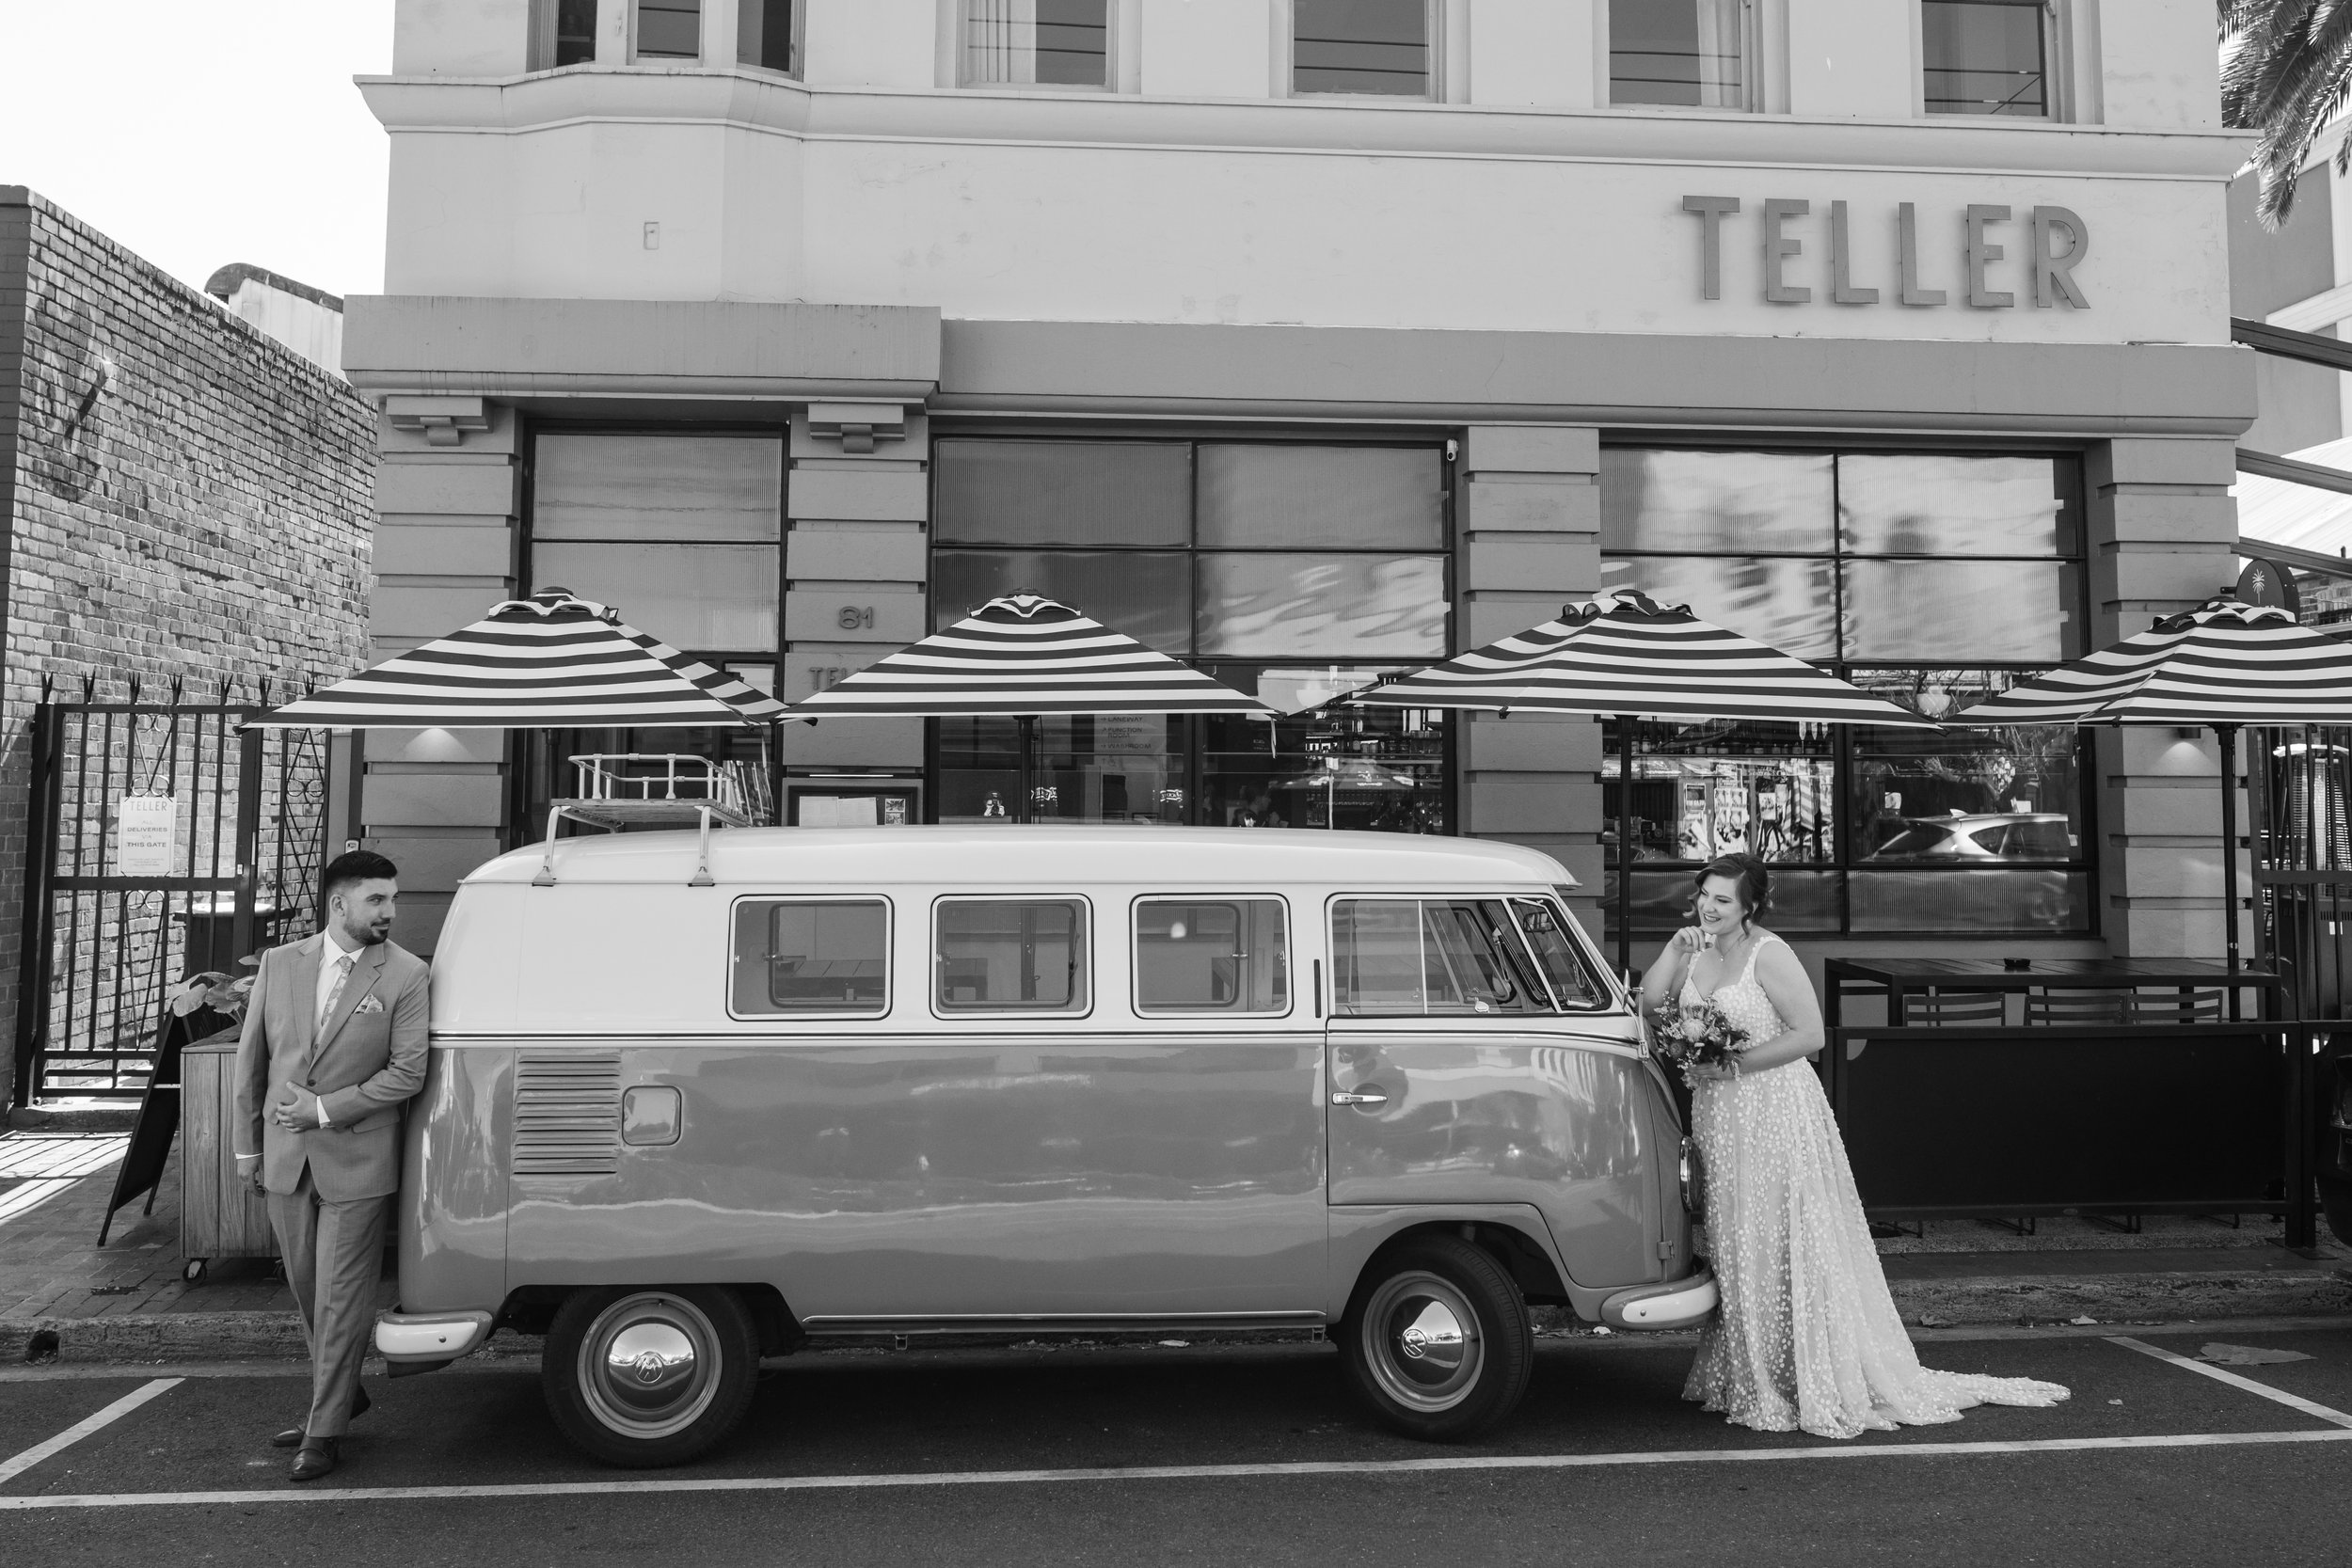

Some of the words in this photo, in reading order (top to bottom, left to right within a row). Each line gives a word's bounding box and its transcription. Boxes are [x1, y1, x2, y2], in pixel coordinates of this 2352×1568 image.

[1682, 195, 2091, 309] TELLER
[838, 606, 873, 629] 81
[130, 800, 167, 812] TELLER
